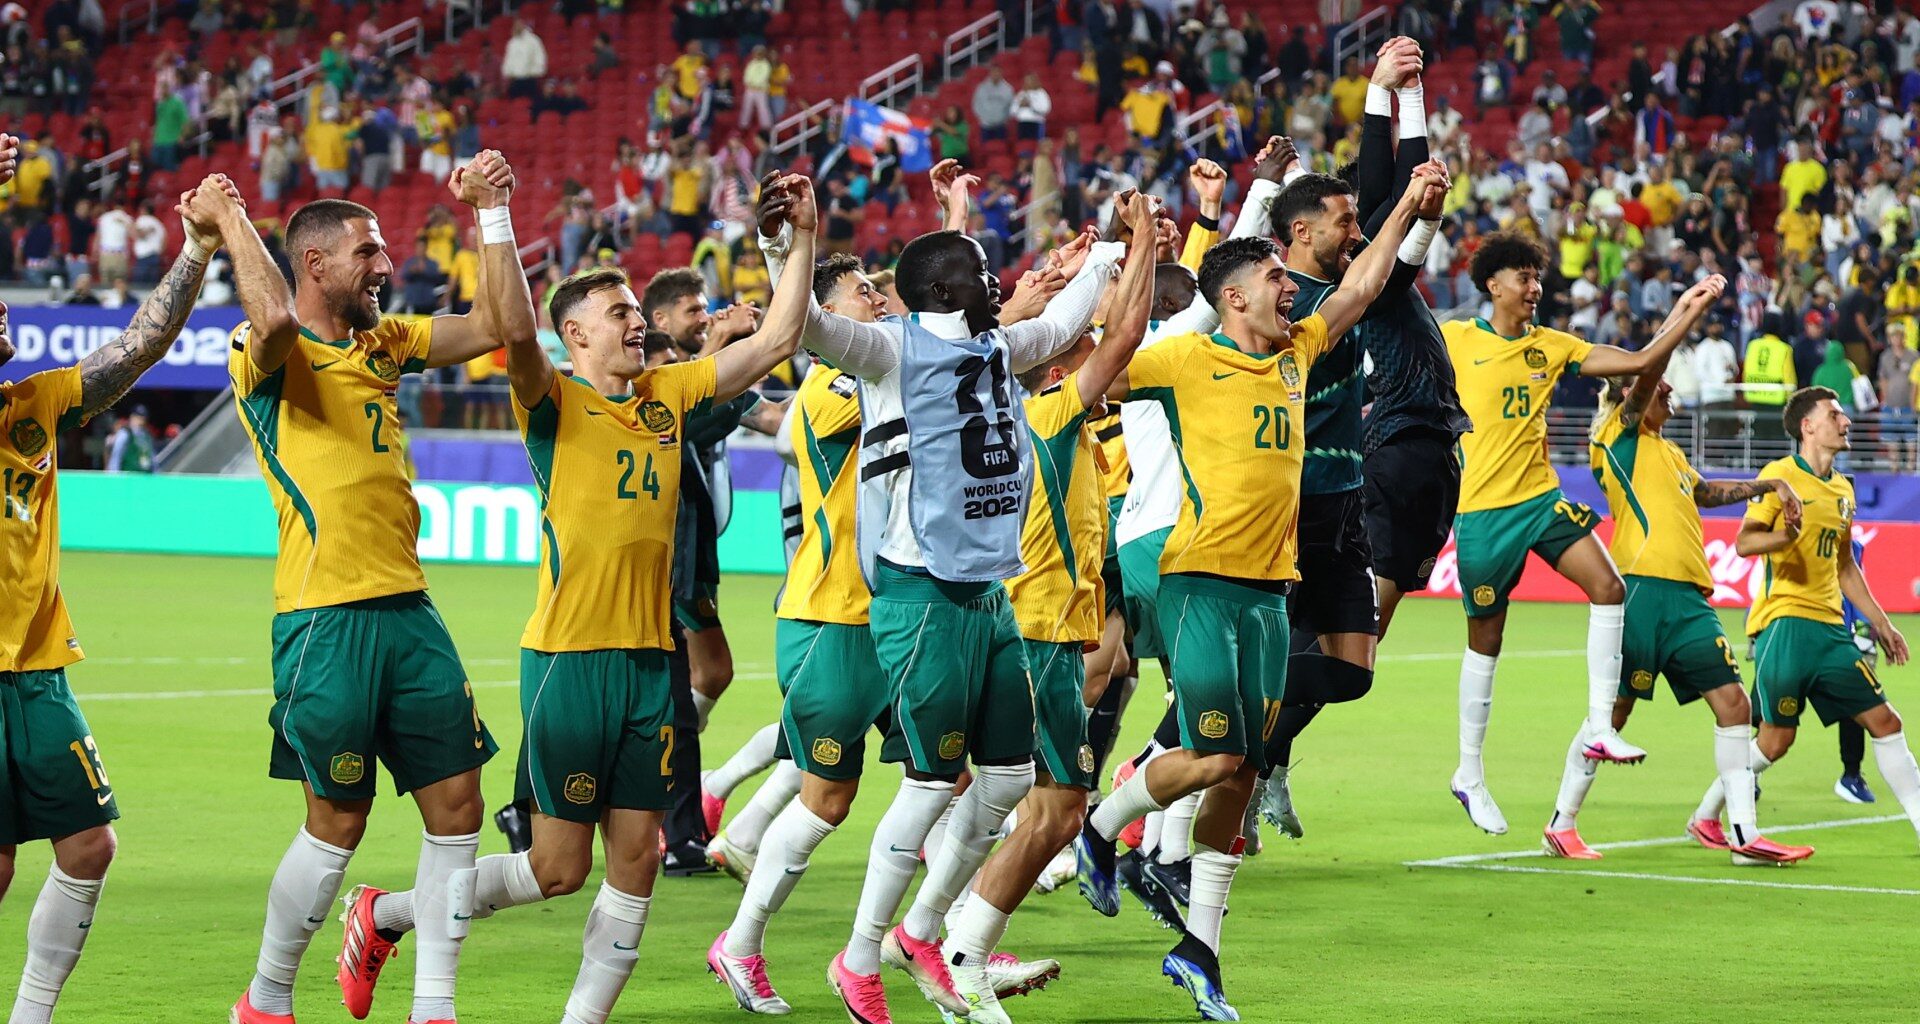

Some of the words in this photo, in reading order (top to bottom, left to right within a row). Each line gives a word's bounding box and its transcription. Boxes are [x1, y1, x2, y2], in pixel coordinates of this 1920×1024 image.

[163, 326, 229, 366] 02
[1503, 386, 1530, 419] 25
[364, 402, 389, 453] 2
[1253, 405, 1290, 450] 20
[616, 449, 660, 500] 24
[982, 449, 1010, 467] FIFA
[3, 467, 37, 519] 13
[963, 482, 1006, 499] WORLD
[1006, 480, 1021, 493] CU
[1817, 527, 1837, 559] 10
[69, 734, 110, 790] 13
[660, 725, 674, 776] 2
